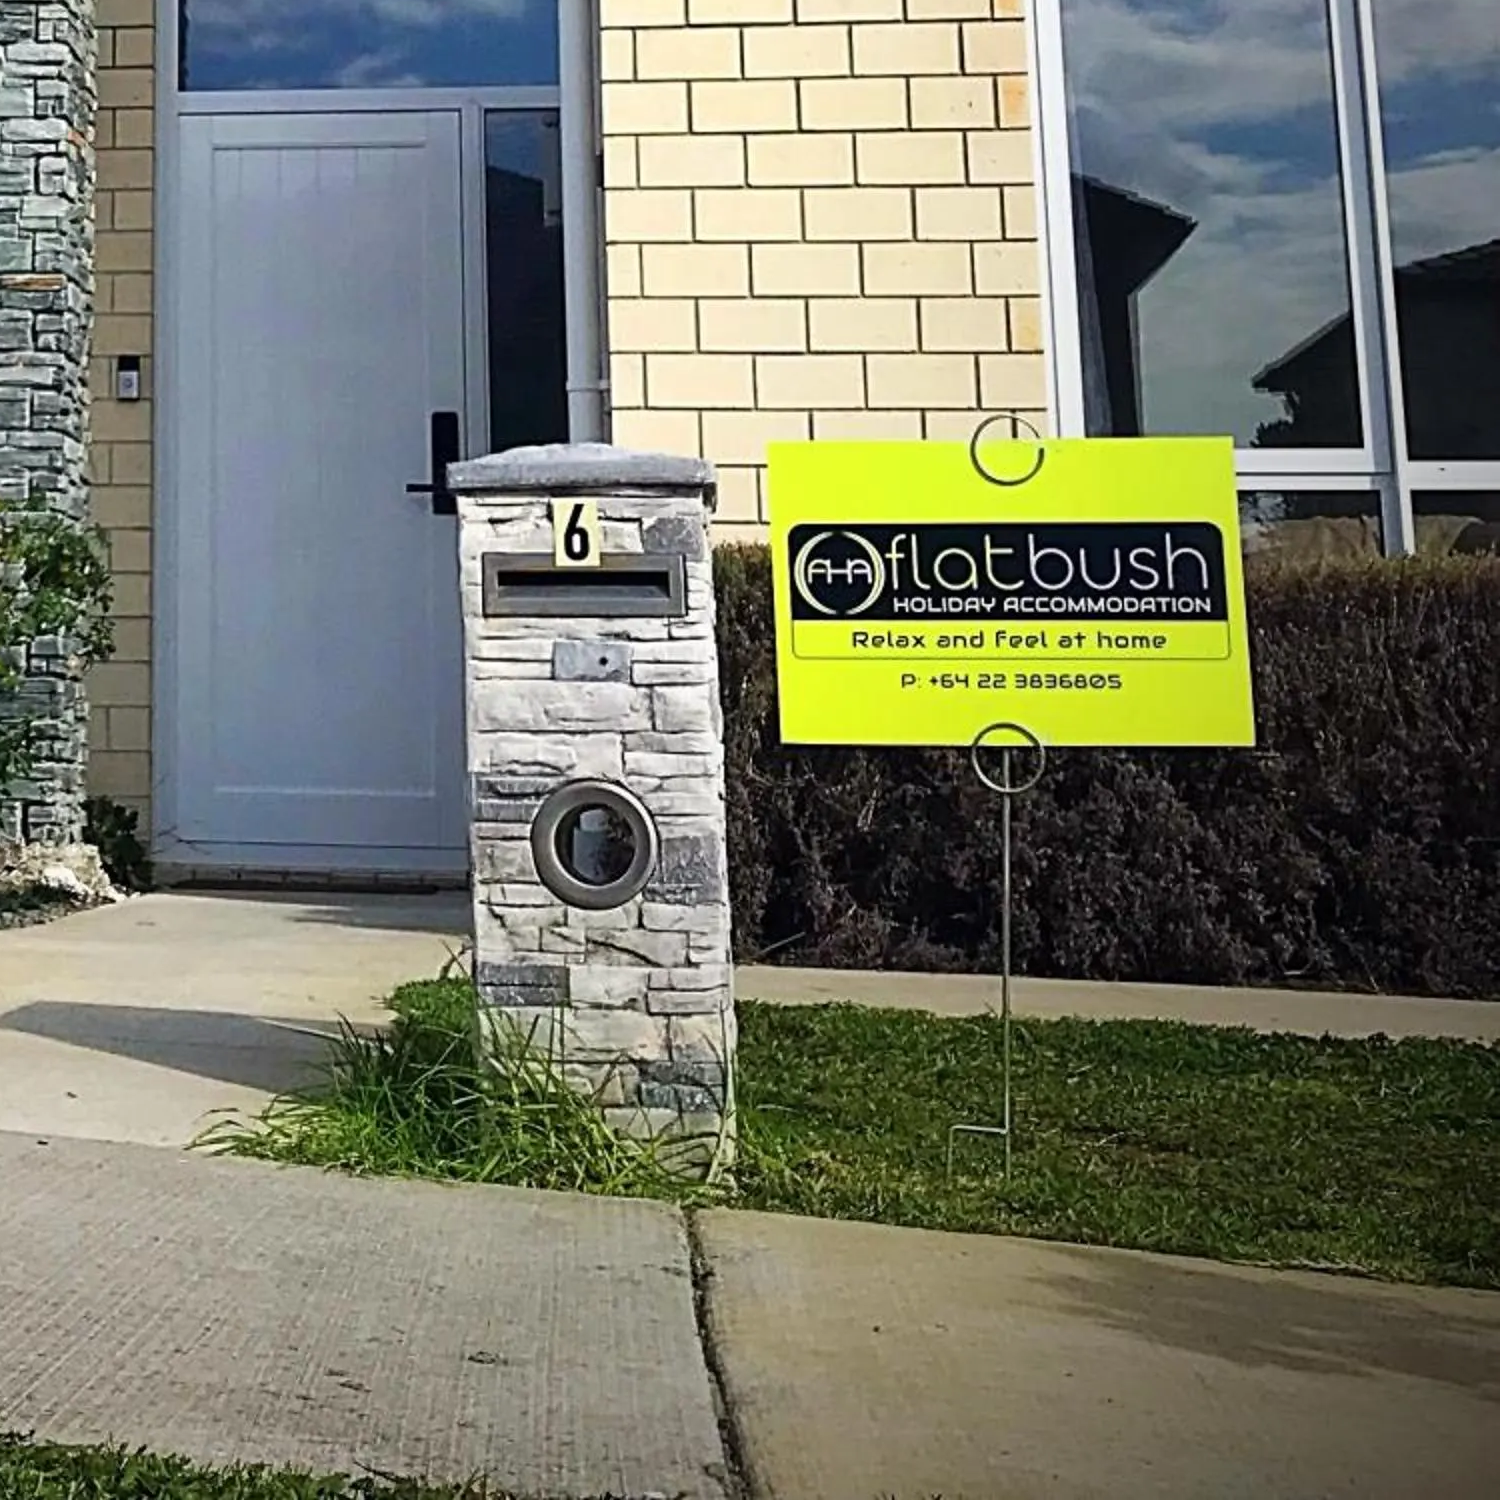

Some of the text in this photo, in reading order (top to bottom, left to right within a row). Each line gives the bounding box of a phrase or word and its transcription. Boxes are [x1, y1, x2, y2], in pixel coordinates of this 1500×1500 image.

[563, 503, 590, 561] 6
[893, 596, 1211, 614] HOLIDAY ACCOMMODATION
[852, 631, 1167, 649] Relax and feel at home
[900, 673, 1122, 689] P: +64 22 3836805
